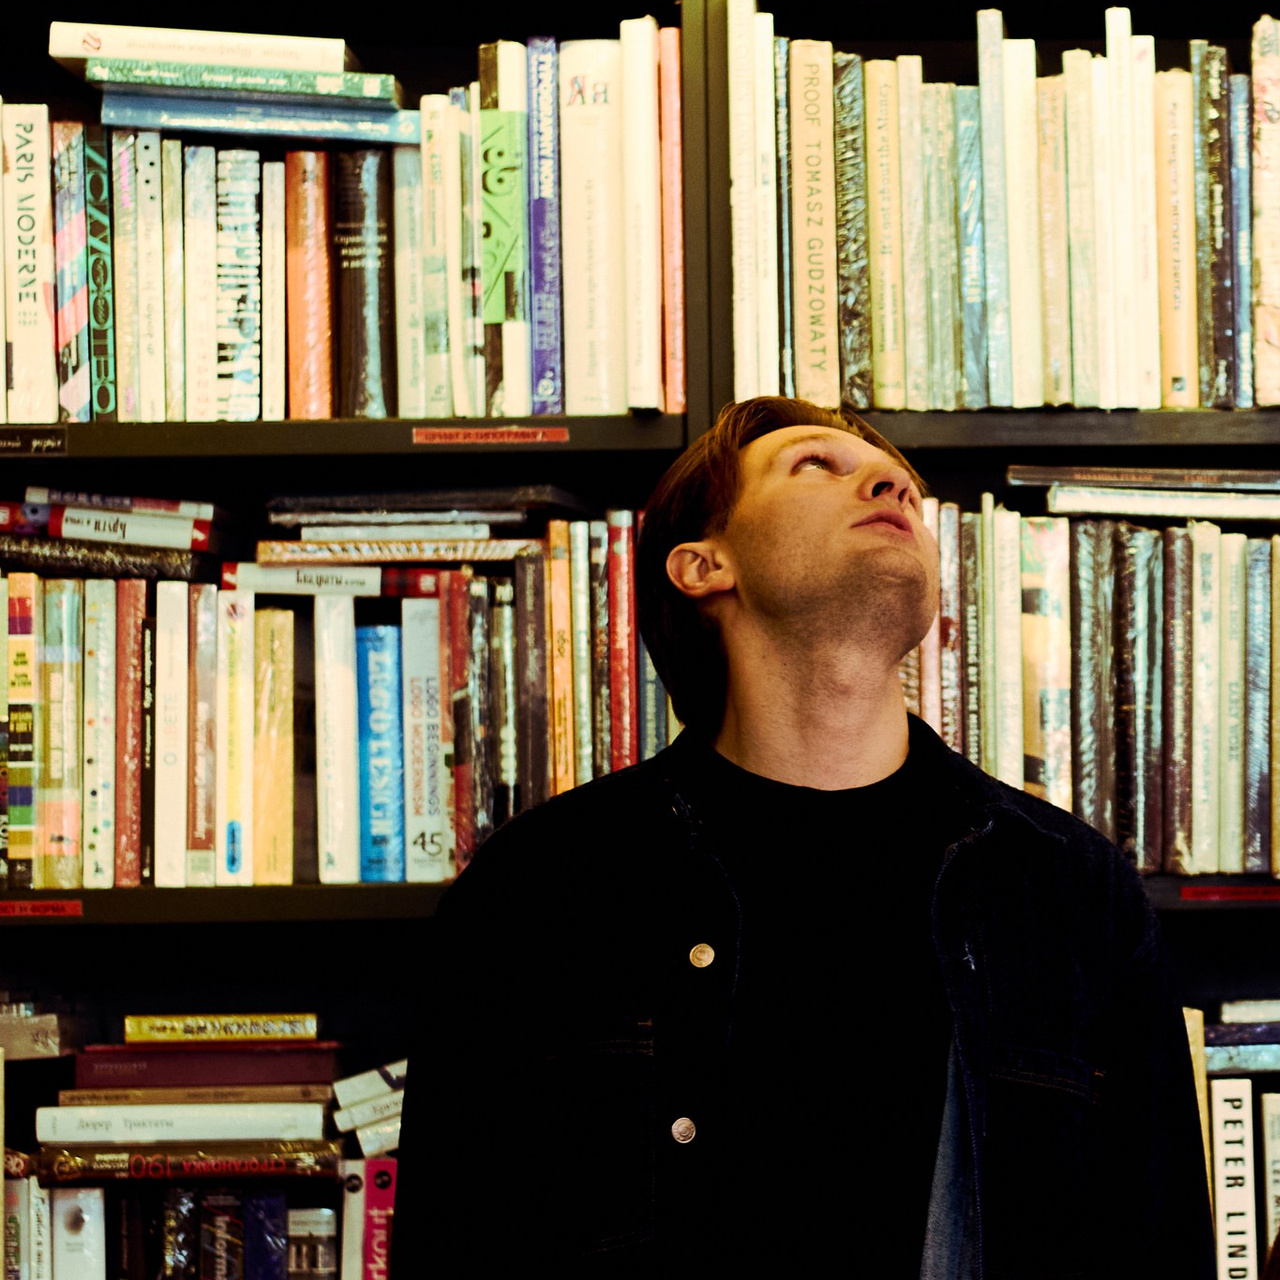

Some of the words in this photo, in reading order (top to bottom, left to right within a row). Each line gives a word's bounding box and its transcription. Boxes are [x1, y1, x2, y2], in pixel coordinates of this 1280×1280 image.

[538, 52, 554, 157] TYPOGRAPHY
[803, 63, 821, 128] PROOF
[877, 83, 893, 131] Money
[15, 122, 37, 184] PARIS
[879, 136, 892, 158] the
[538, 159, 553, 199] NOW
[805, 140, 824, 229] TOMASZ
[879, 163, 893, 202] about
[15, 193, 37, 303] MODERNE
[807, 238, 826, 373] GUDZOWATY
[1172, 257, 1182, 311] Journals
[966, 604, 978, 664] SLEEPING
[966, 665, 978, 682] BY
[411, 676, 424, 718] LOGO
[426, 676, 438, 718] LOGO
[967, 685, 979, 711] THE
[1228, 681, 1239, 719] EARLY
[1228, 723, 1239, 762] WORK
[411, 724, 424, 817] MODERNISM
[426, 722, 439, 817] BEGINNINGS
[413, 831, 443, 858] 45
[1222, 1097, 1244, 1188] PETER
[130, 1152, 172, 1179] 190
[182, 1158, 287, 1174] СТРОГАНОВКА
